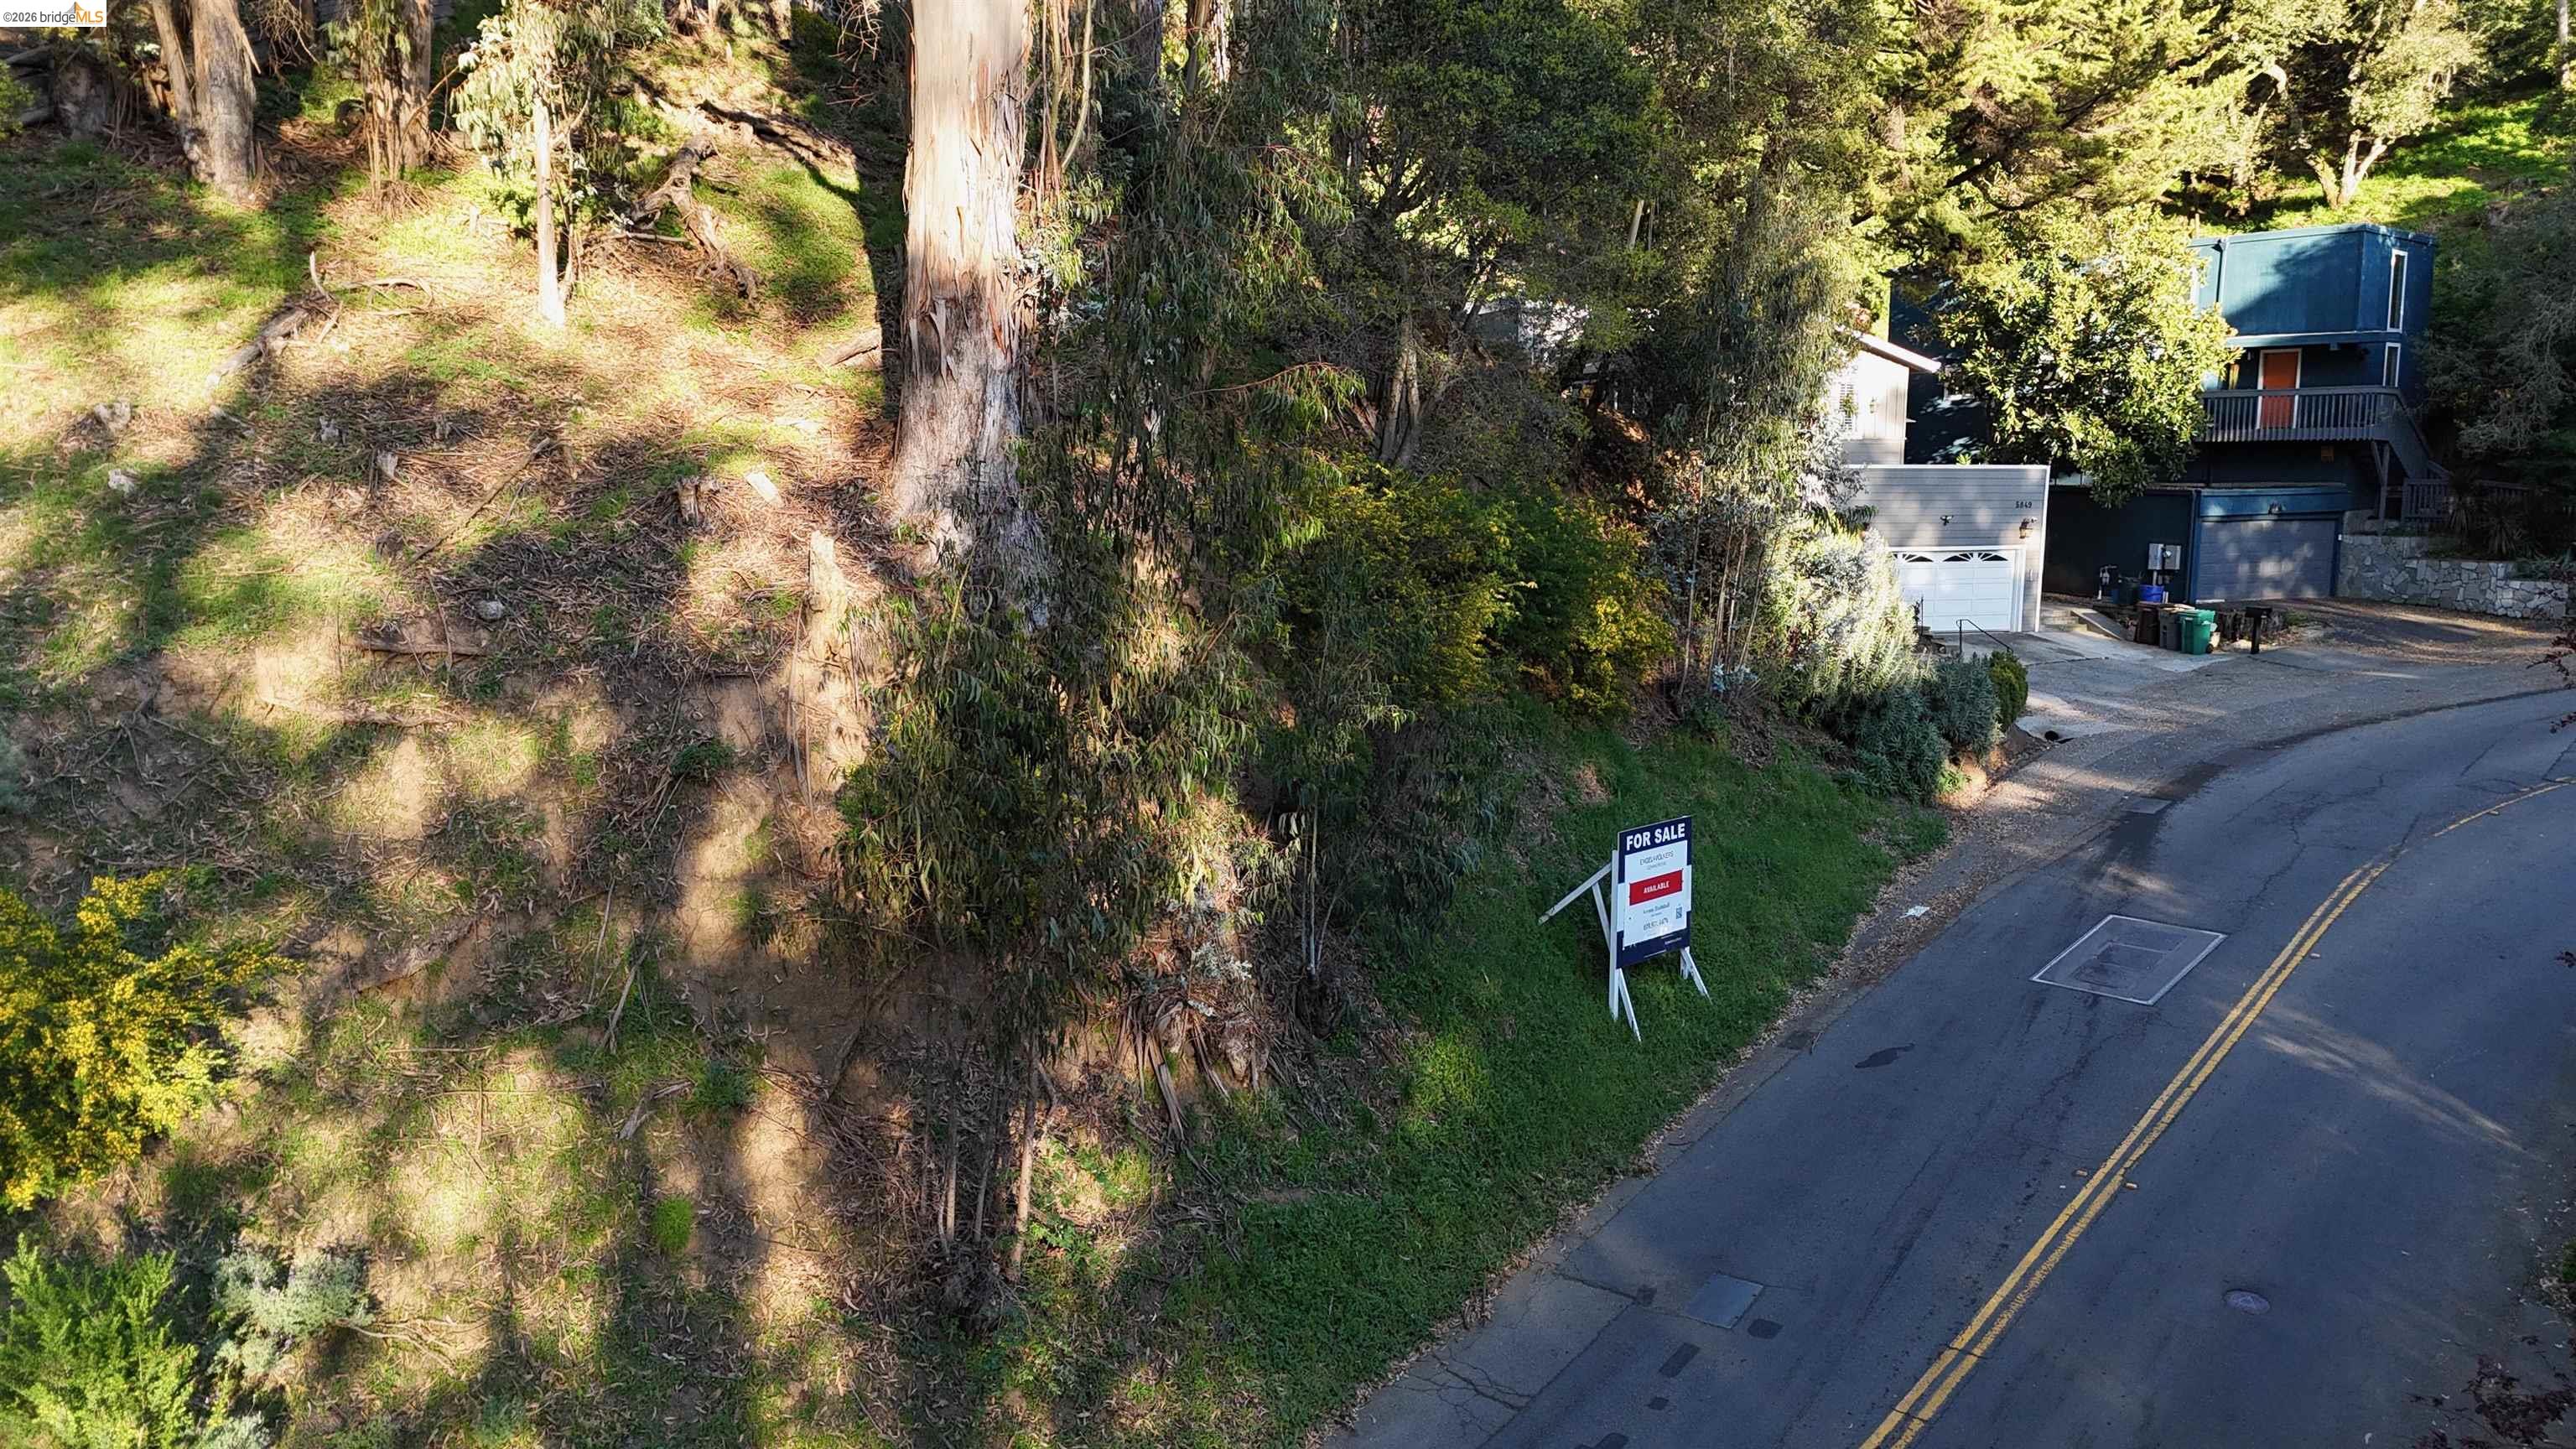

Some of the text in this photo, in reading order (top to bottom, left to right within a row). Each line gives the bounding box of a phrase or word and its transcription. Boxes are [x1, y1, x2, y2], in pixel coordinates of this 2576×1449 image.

[1626, 823, 1685, 851] FOR SALE
[1644, 880, 1670, 894] AVAILABLE
